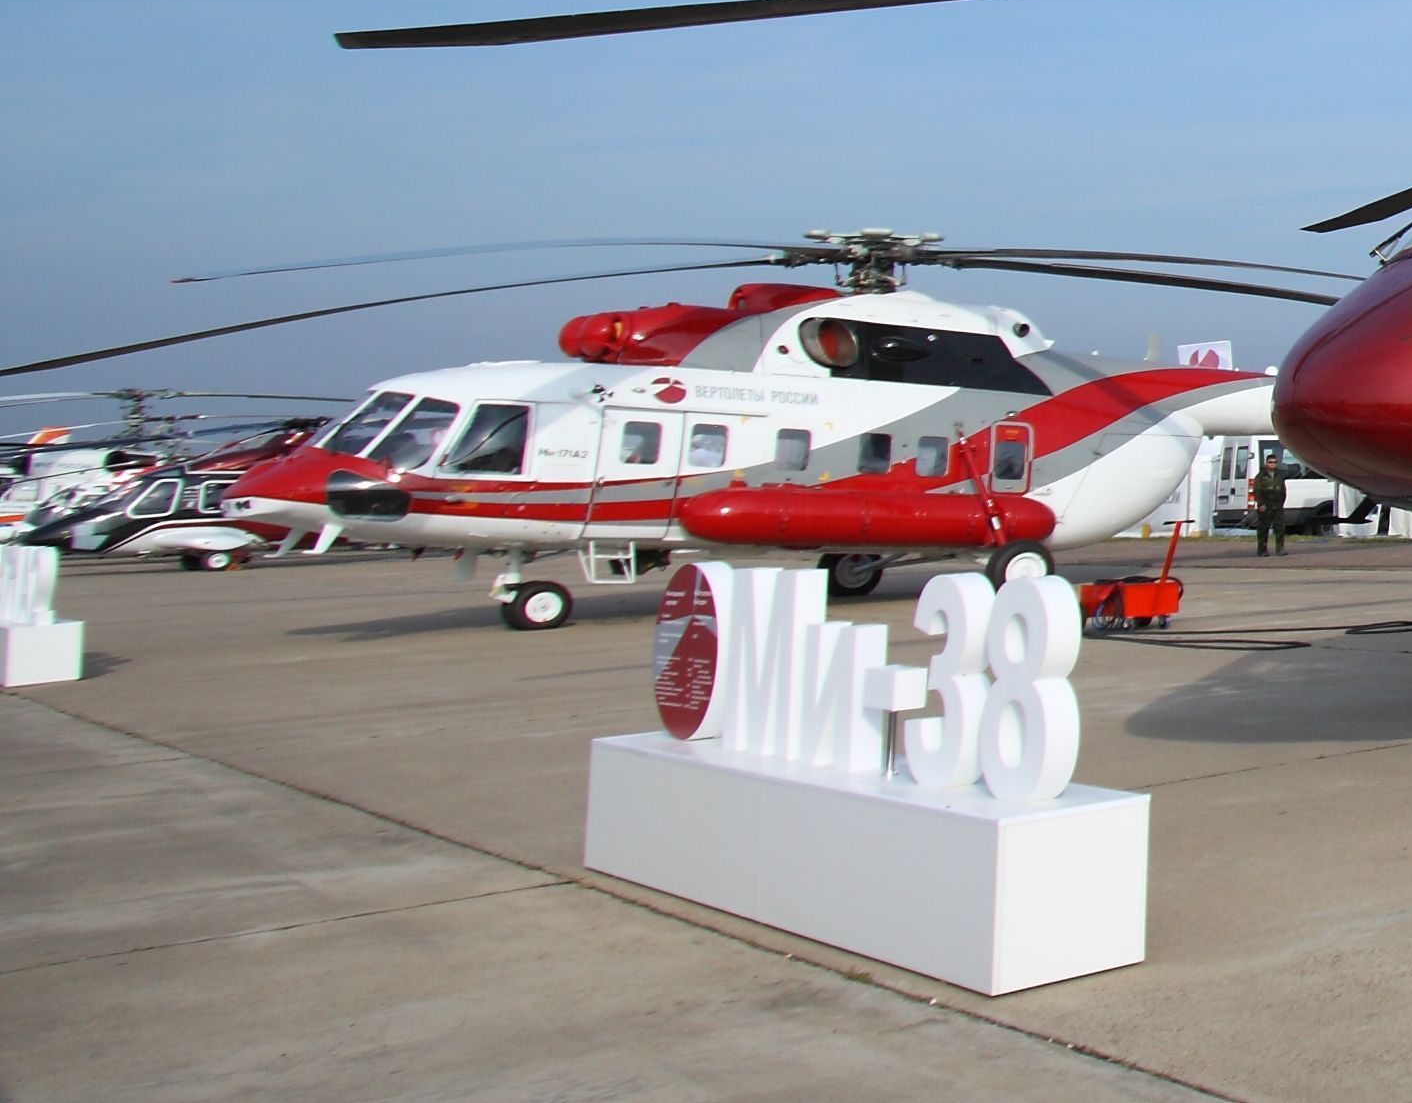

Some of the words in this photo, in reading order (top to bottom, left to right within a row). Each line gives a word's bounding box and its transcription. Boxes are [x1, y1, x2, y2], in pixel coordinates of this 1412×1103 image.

[695, 385, 765, 402] ВЕРТОЛЕТЫ
[771, 390, 819, 405] РОССИИ
[722, 567, 1082, 801] Ми-38
